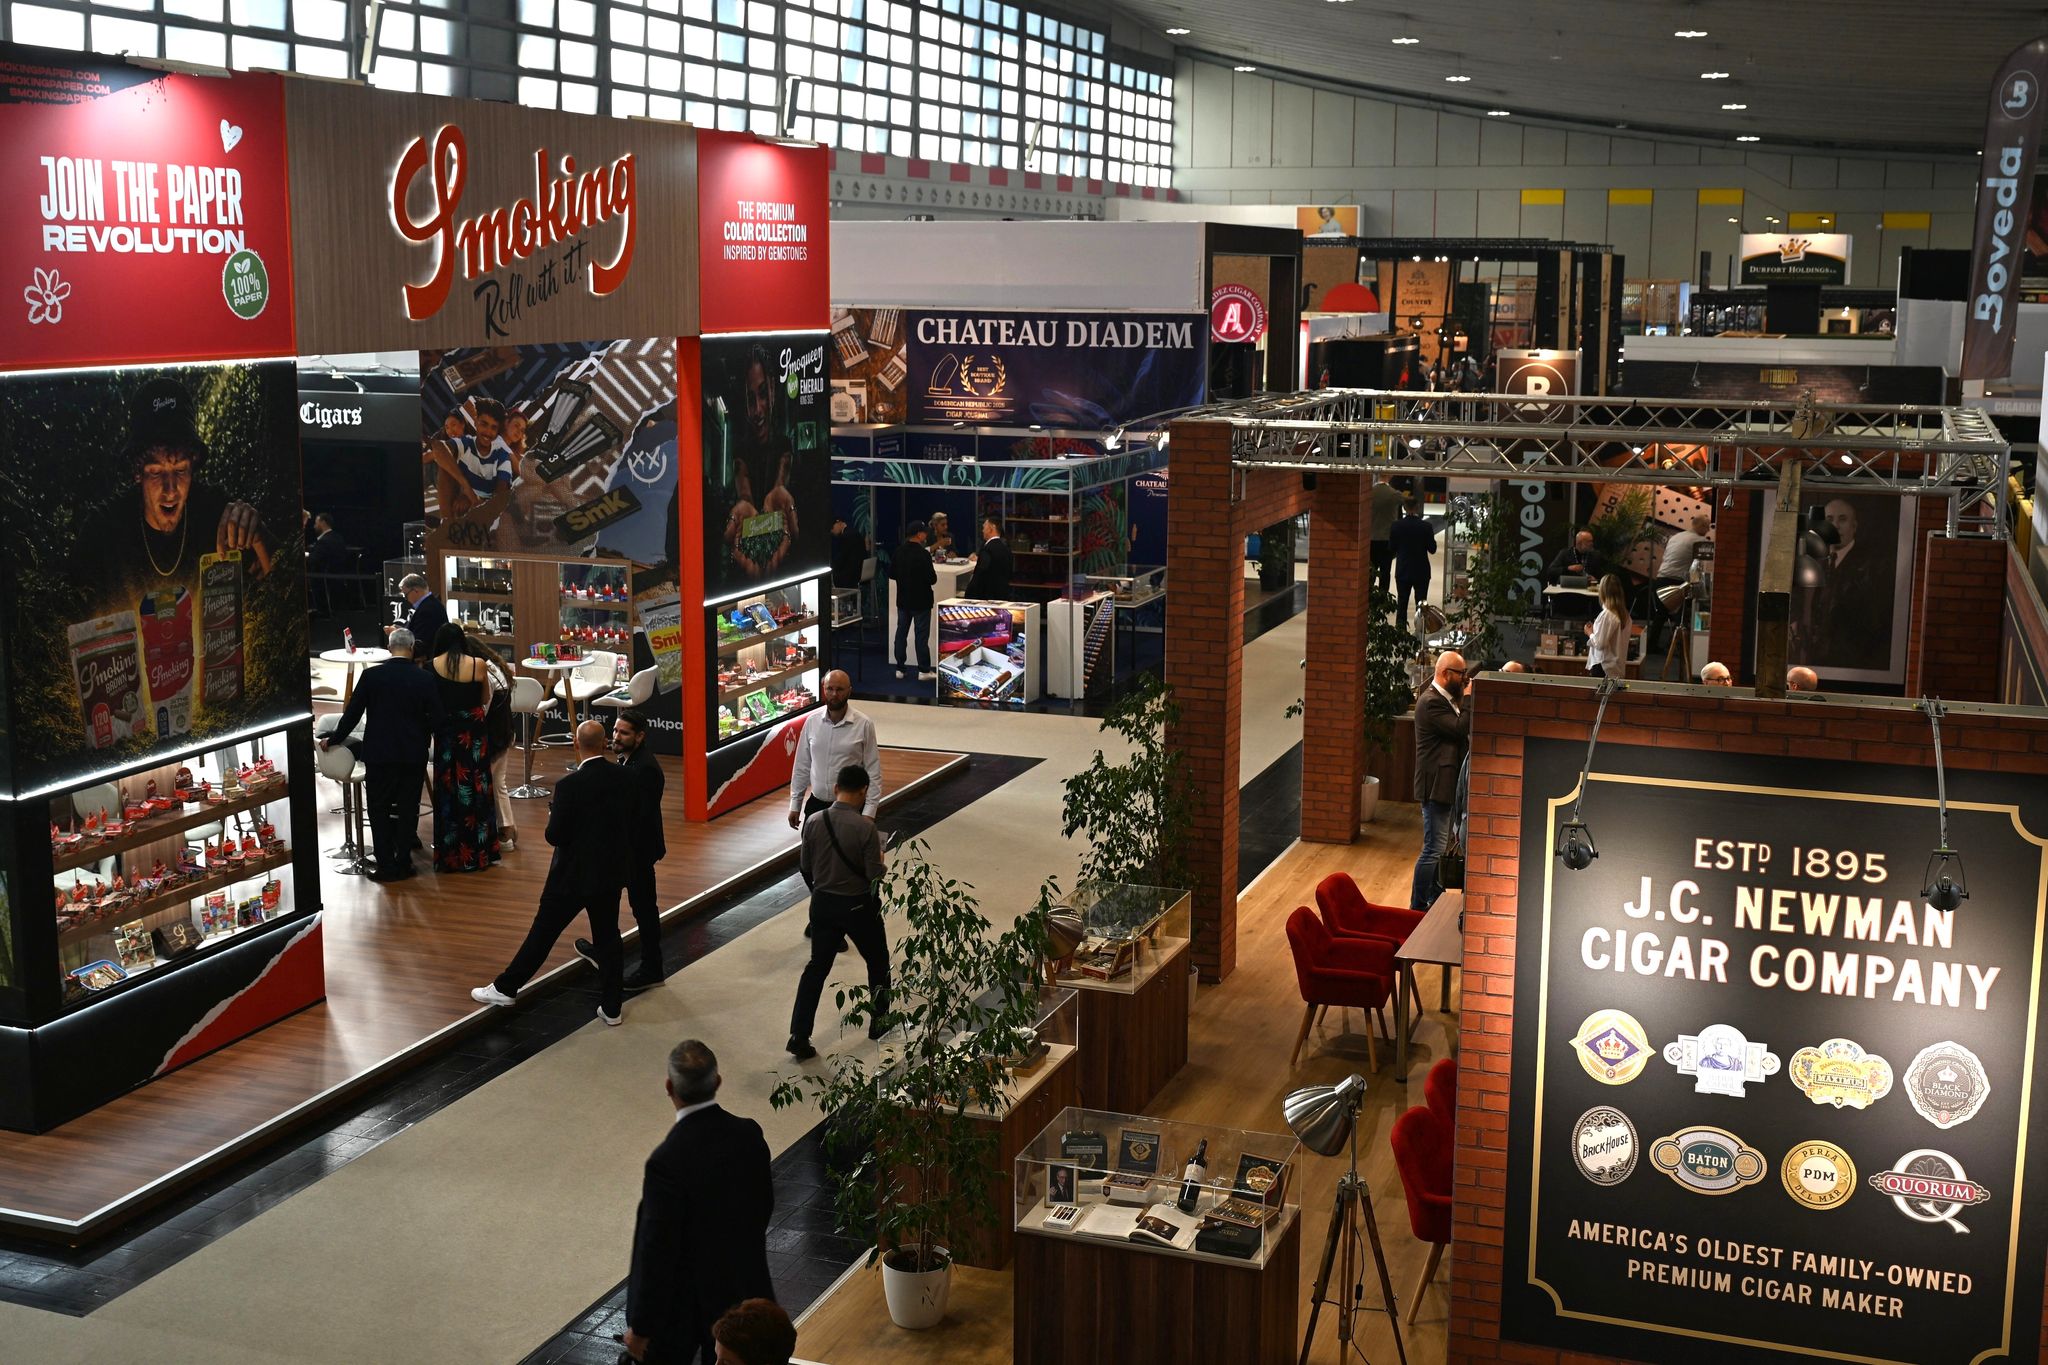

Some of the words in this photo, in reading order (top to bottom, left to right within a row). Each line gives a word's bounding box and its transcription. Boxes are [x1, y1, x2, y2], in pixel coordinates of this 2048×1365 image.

[40, 156, 104, 221] JOIN
[112, 160, 160, 223] THE
[167, 164, 243, 225] PAPER
[390, 123, 637, 320] Smoking
[737, 200, 754, 219] THE
[756, 202, 795, 221] PREMIUM
[43, 225, 245, 254] REVOLUTION
[723, 221, 754, 241] COLOR
[755, 223, 807, 242] COLLECTION
[1974, 146, 2022, 334] Boveda
[723, 244, 756, 260] INSPIRED
[758, 245, 768, 260] BY
[768, 246, 808, 260] GEMSTONES
[231, 272, 261, 298] 100%
[233, 291, 263, 307] PAPER
[474, 273, 522, 339] Roll
[527, 259, 559, 307] with
[917, 317, 1058, 347] CHATEAU
[1066, 320, 1195, 350] DIADEM
[800, 377, 824, 394] EMERALD
[299, 401, 363, 429] Cigars
[1135, 480, 1168, 488] CHATEAU
[151, 658, 190, 688] Smoking
[1792, 846, 1889, 884] 1895
[1623, 876, 1714, 926] J.C.
[1734, 885, 1955, 949] NEWMAN
[1580, 926, 1728, 984] CIGAR
[1749, 944, 2002, 1011] COMPANY
[1816, 1073, 1865, 1087] MAXIMUS
[1932, 1082, 1961, 1091] BLACK
[1924, 1087, 1969, 1099] DIAMOND
[1687, 1152, 1729, 1168] BATON
[1803, 1148, 1838, 1162] PERLA
[1803, 1168, 1835, 1182] PDM
[1794, 1184, 1813, 1201] DEL
[1819, 1189, 1843, 1202] MAR
[1886, 1177, 1971, 1200] QUORUM
[1567, 1219, 1688, 1254] AMERICA'S
[1697, 1237, 1784, 1268] OLDEST
[1792, 1251, 1973, 1295] FAMILY-OWNED
[1627, 1259, 1732, 1293] PREMIUM
[1741, 1276, 1812, 1305] CIGAR
[1821, 1289, 1905, 1318] MAKER
